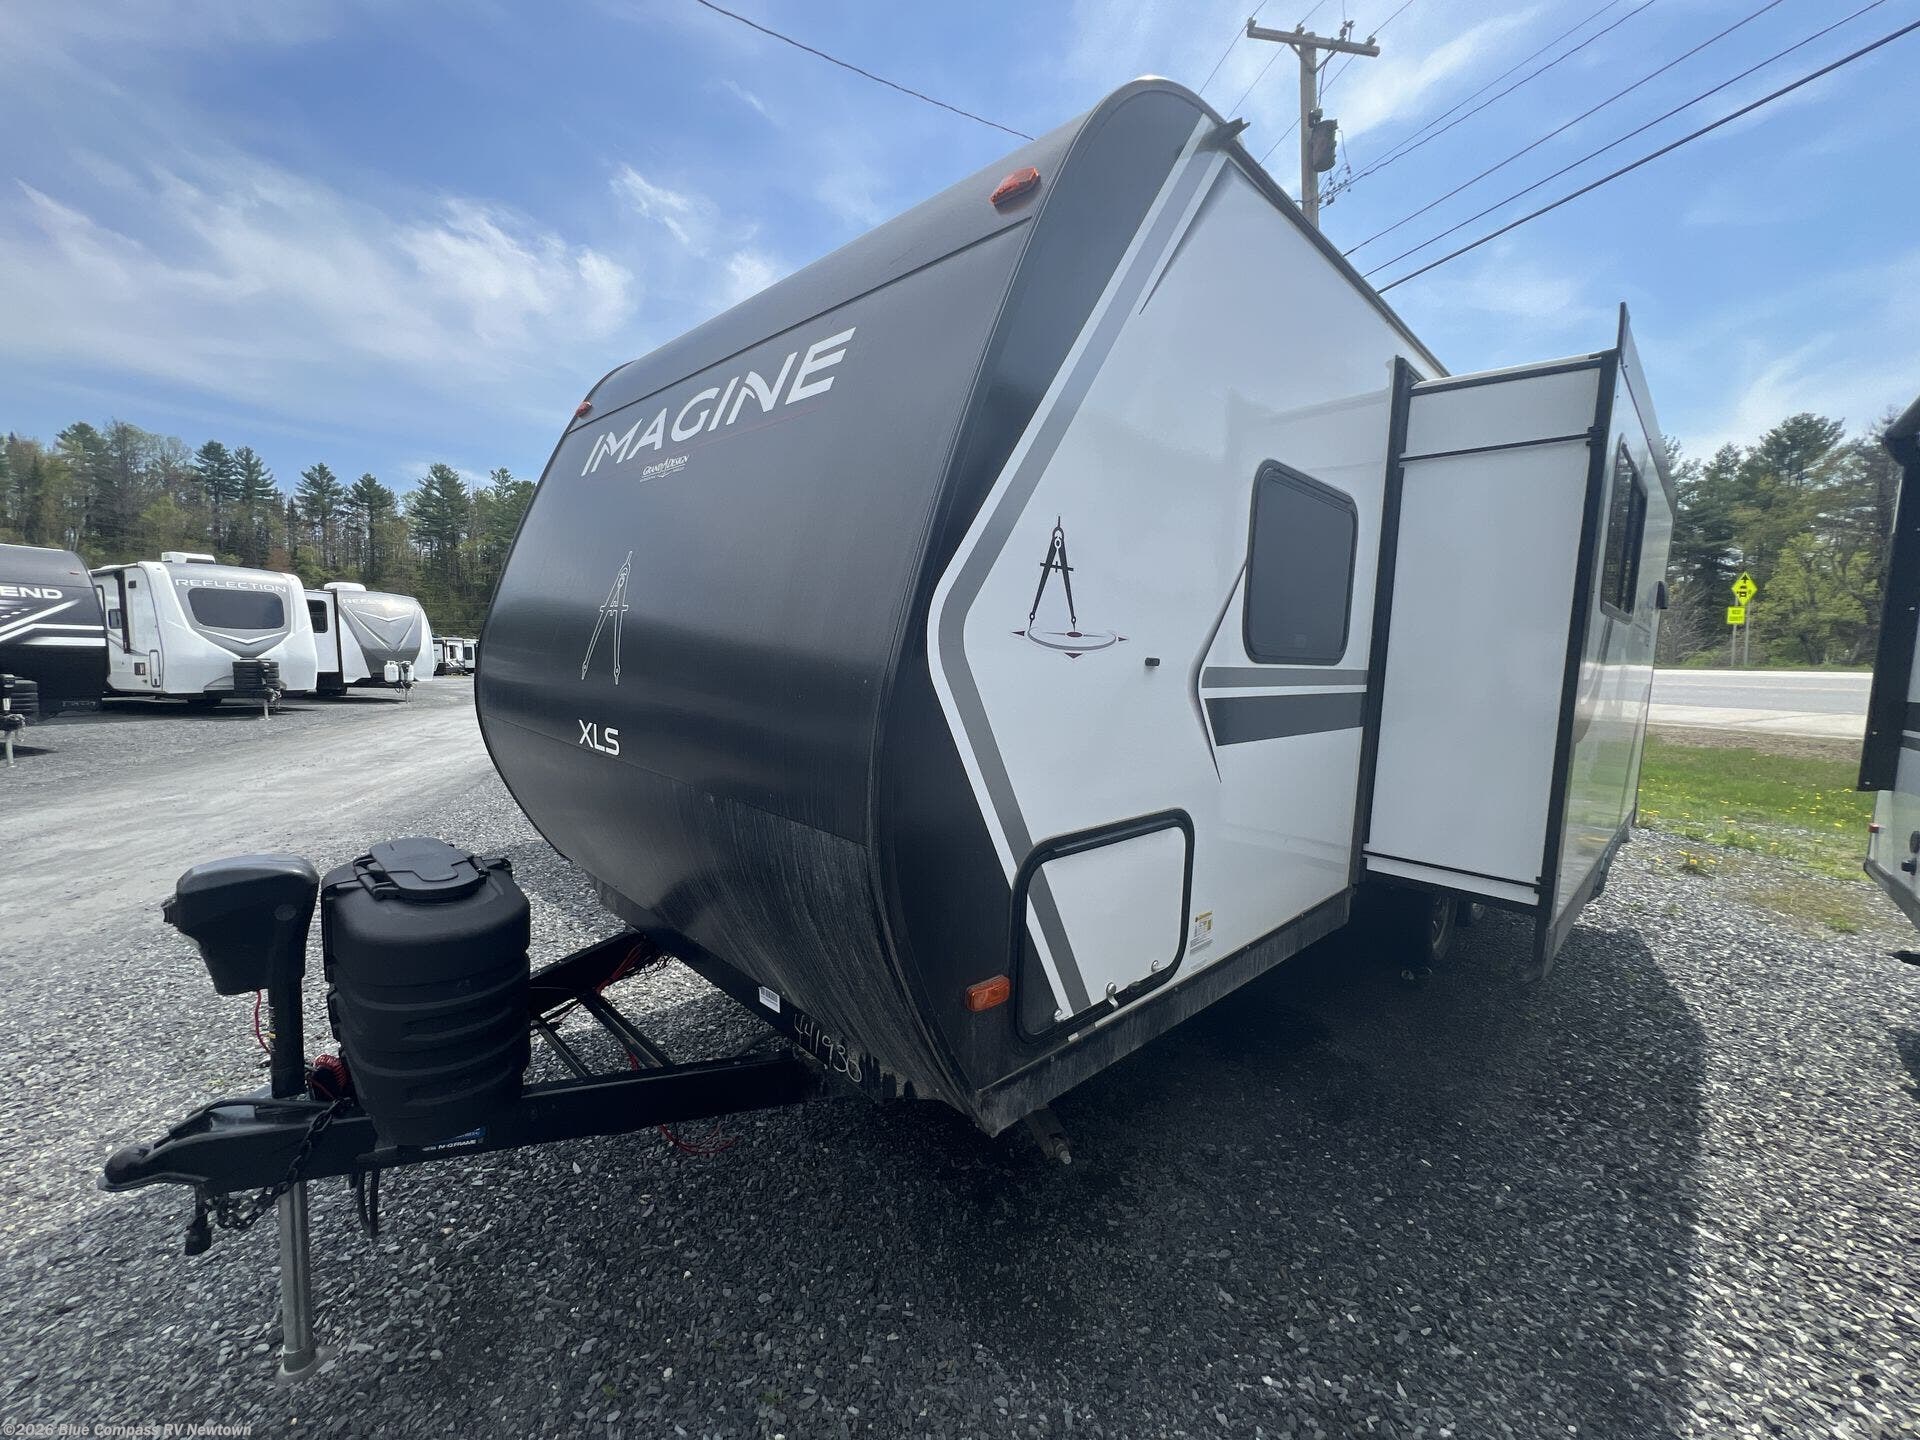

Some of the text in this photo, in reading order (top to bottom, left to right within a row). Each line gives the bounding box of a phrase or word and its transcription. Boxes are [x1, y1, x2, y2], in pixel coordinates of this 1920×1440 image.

[581, 327, 856, 477] IMAGINE
[175, 578, 287, 593] REFLECTION
[578, 719, 620, 756] XLS
